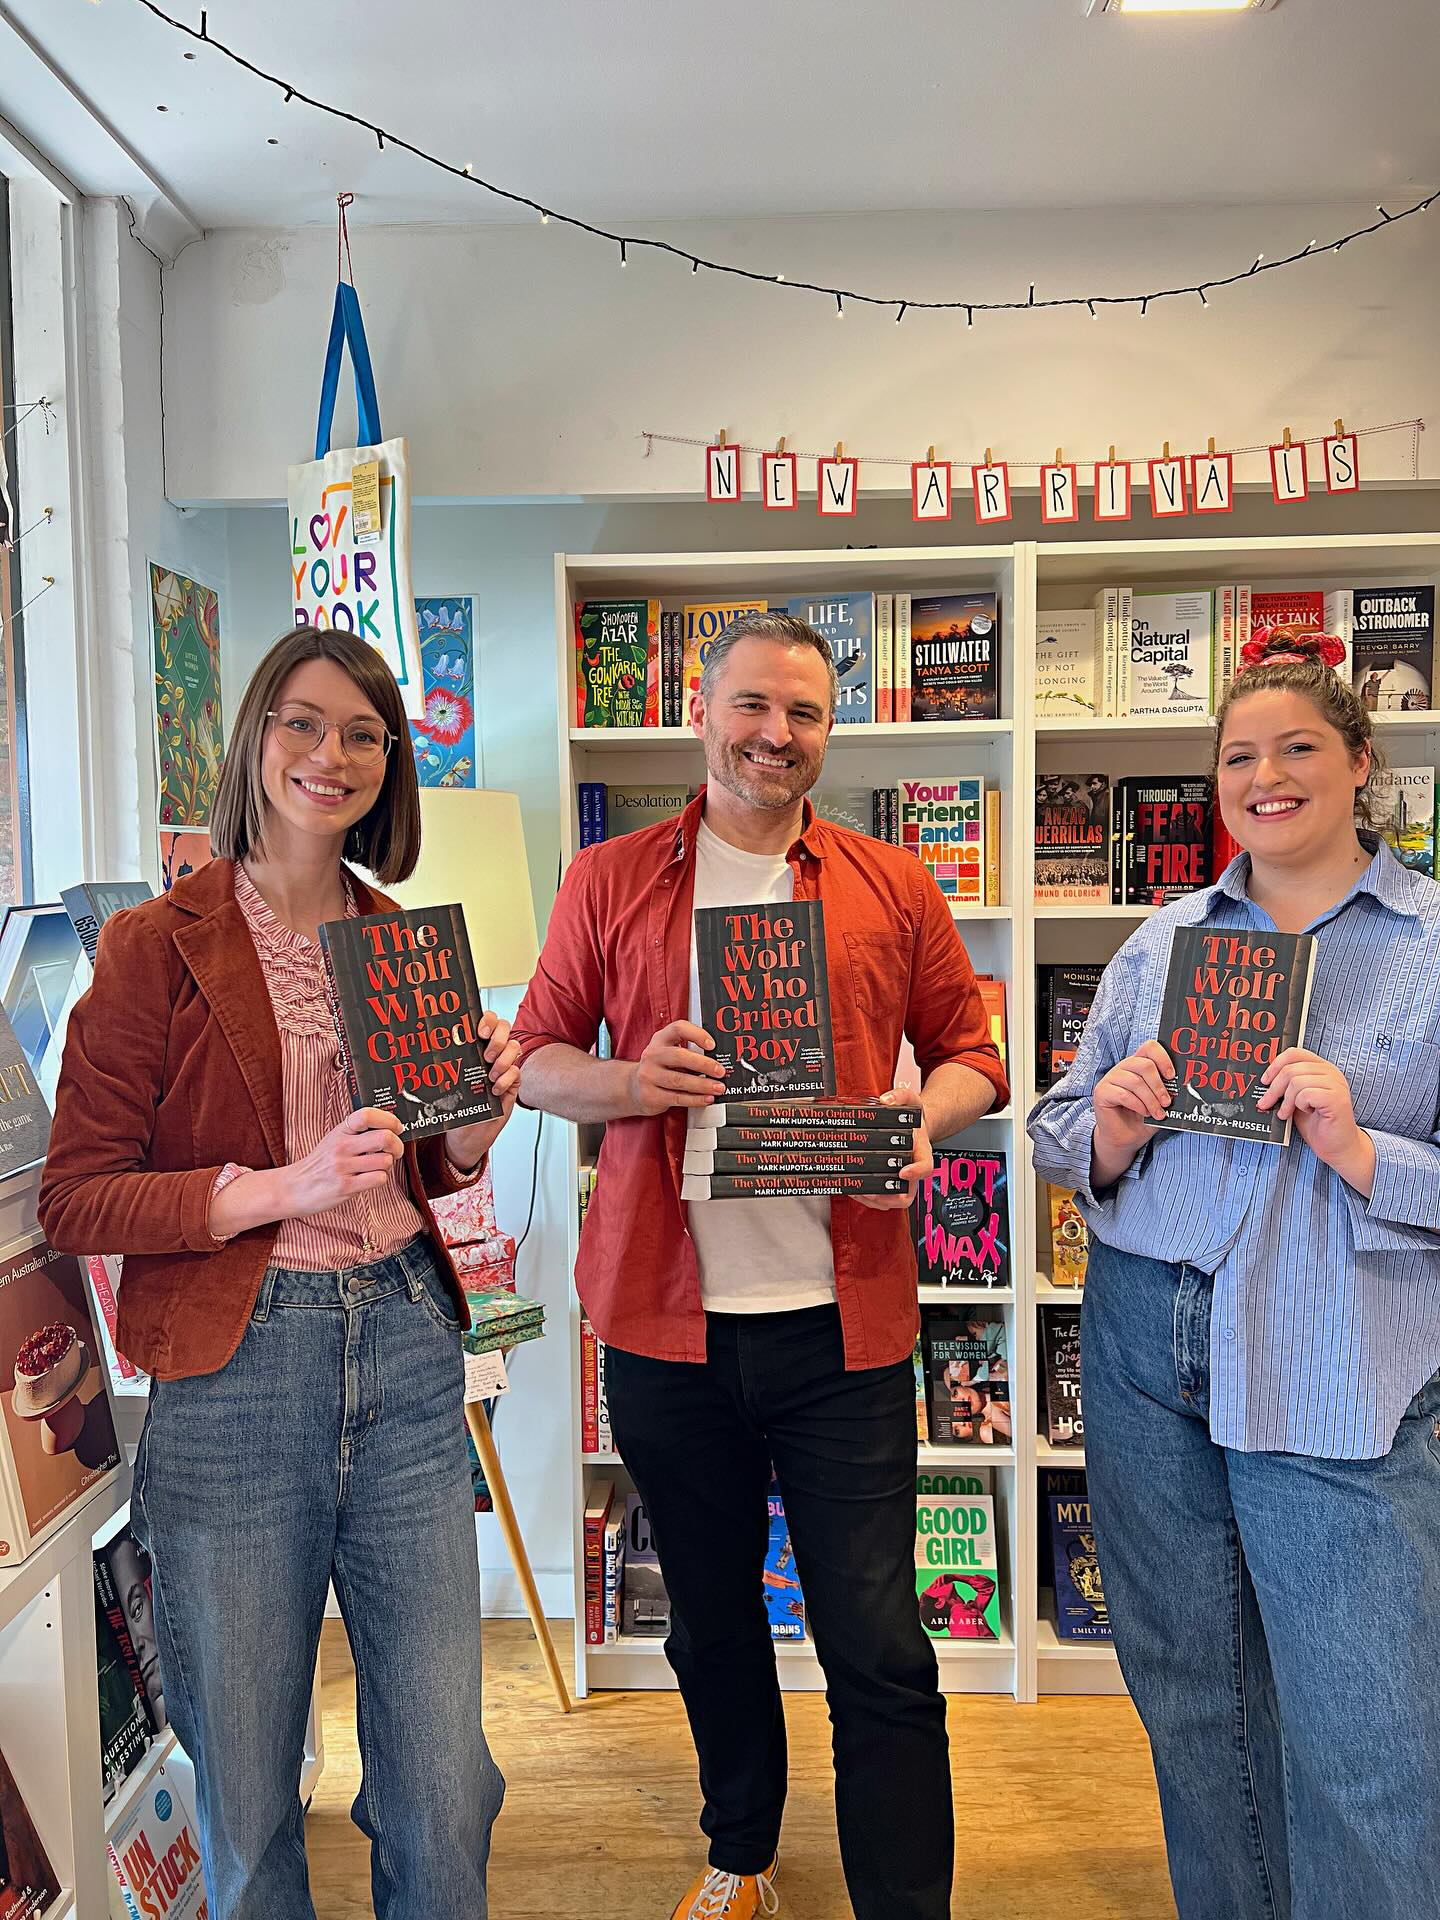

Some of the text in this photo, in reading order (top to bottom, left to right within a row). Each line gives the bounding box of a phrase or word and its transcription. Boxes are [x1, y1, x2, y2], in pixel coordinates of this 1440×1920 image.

[716, 444, 1353, 513] NEW ARRIVALS
[292, 551, 378, 601] YOUR
[808, 603, 853, 626] LIFE,
[1360, 596, 1417, 614] OUTBACK
[1105, 596, 1116, 652] Blindspotting
[1120, 596, 1131, 652] Blindspotting
[1131, 619, 1149, 631] On
[1223, 616, 1232, 642] OUTLAWS
[1251, 611, 1320, 627] NAKE TALK
[1352, 612, 1430, 631] ASTRONOMER
[600, 625, 638, 643] AZAR
[1131, 629, 1190, 647] Natural
[599, 646, 622, 666] THE
[915, 639, 990, 666] STILLWATER
[1131, 646, 1188, 666] Capital
[588, 661, 645, 686] GOWKARAN
[916, 663, 990, 676] TANYA SCOTT
[591, 685, 613, 708] TREE
[616, 710, 643, 727] KITCHEN
[1130, 705, 1204, 715] PARTHA DASGUPTA
[615, 794, 682, 808] Desolation
[902, 782, 958, 803] Your
[1137, 789, 1178, 802] THROUGH
[902, 801, 980, 822] Friend
[1044, 806, 1087, 826] ANZAC
[920, 826, 964, 843] and
[1036, 825, 1103, 844] UERRILLAS
[920, 843, 980, 864] Mine
[1136, 845, 1146, 863] AND
[1146, 843, 1205, 883] FIRE
[1063, 889, 1101, 898] GOLDRICK
[725, 912, 794, 941] The
[362, 920, 439, 956] The
[723, 940, 806, 972] Wolf
[1202, 935, 1277, 968] The
[365, 948, 453, 992] Wolf
[719, 971, 808, 1002] Who
[1194, 966, 1286, 1001] Wolf
[365, 984, 461, 1026] Who
[1185, 996, 1277, 1033] Who
[715, 1000, 819, 1033] Cried
[366, 1013, 477, 1063] Cried
[1170, 1026, 1281, 1065] Cried
[734, 1035, 801, 1066] Boy
[392, 1057, 463, 1096] Boy
[1183, 1059, 1257, 1099] Boy
[723, 1082, 825, 1096] ARK MUPOTSA-RUSSELL
[410, 1102, 492, 1130] MUPOTSA-RUSSELL
[748, 1107, 877, 1120] The Wolf Who Cried Boy
[791, 1118, 856, 1126] MUPOTSA-RUSSELL
[1183, 1112, 1272, 1134] MUPOTSA-RUSSELL
[738, 1130, 869, 1143] The Wolf Who Cried Boy
[761, 1140, 848, 1148] MARK MUPOTSA-RUSSELL
[735, 1154, 866, 1165] The Wolf Who Cried Boy
[757, 1164, 845, 1172] MARK MUPOTSA-RUSSELL
[733, 1177, 863, 1188] The Wolf Who Cried Boy
[755, 1187, 842, 1196] MARK MUPOTSA-RUSSELL
[924, 1157, 1001, 1214] HOT
[924, 1212, 1002, 1274] WAX
[11, 1257, 48, 1282] Australian
[949, 1268, 964, 1281] M.
[967, 1270, 978, 1281] L.
[97, 1282, 116, 1318] HEART
[1052, 1327, 1068, 1339] The
[932, 1341, 986, 1351] TELEVISION
[933, 1351, 987, 1360] FOR WOMEN
[1062, 1341, 1072, 1350] of
[917, 1474, 984, 1495] GOOD
[917, 1506, 987, 1535] GOOD
[926, 1537, 982, 1566] GIRL
[606, 1554, 616, 1627] BACK IN THE DAY
[930, 1617, 984, 1625] ARIA ABER
[103, 1715, 142, 1766] QUESTION
[105, 1727, 146, 1783] PALESTINE
[123, 1830, 157, 1892] UN
[139, 1825, 200, 1920] STUCK
[25, 1888, 48, 1918] Anderson
